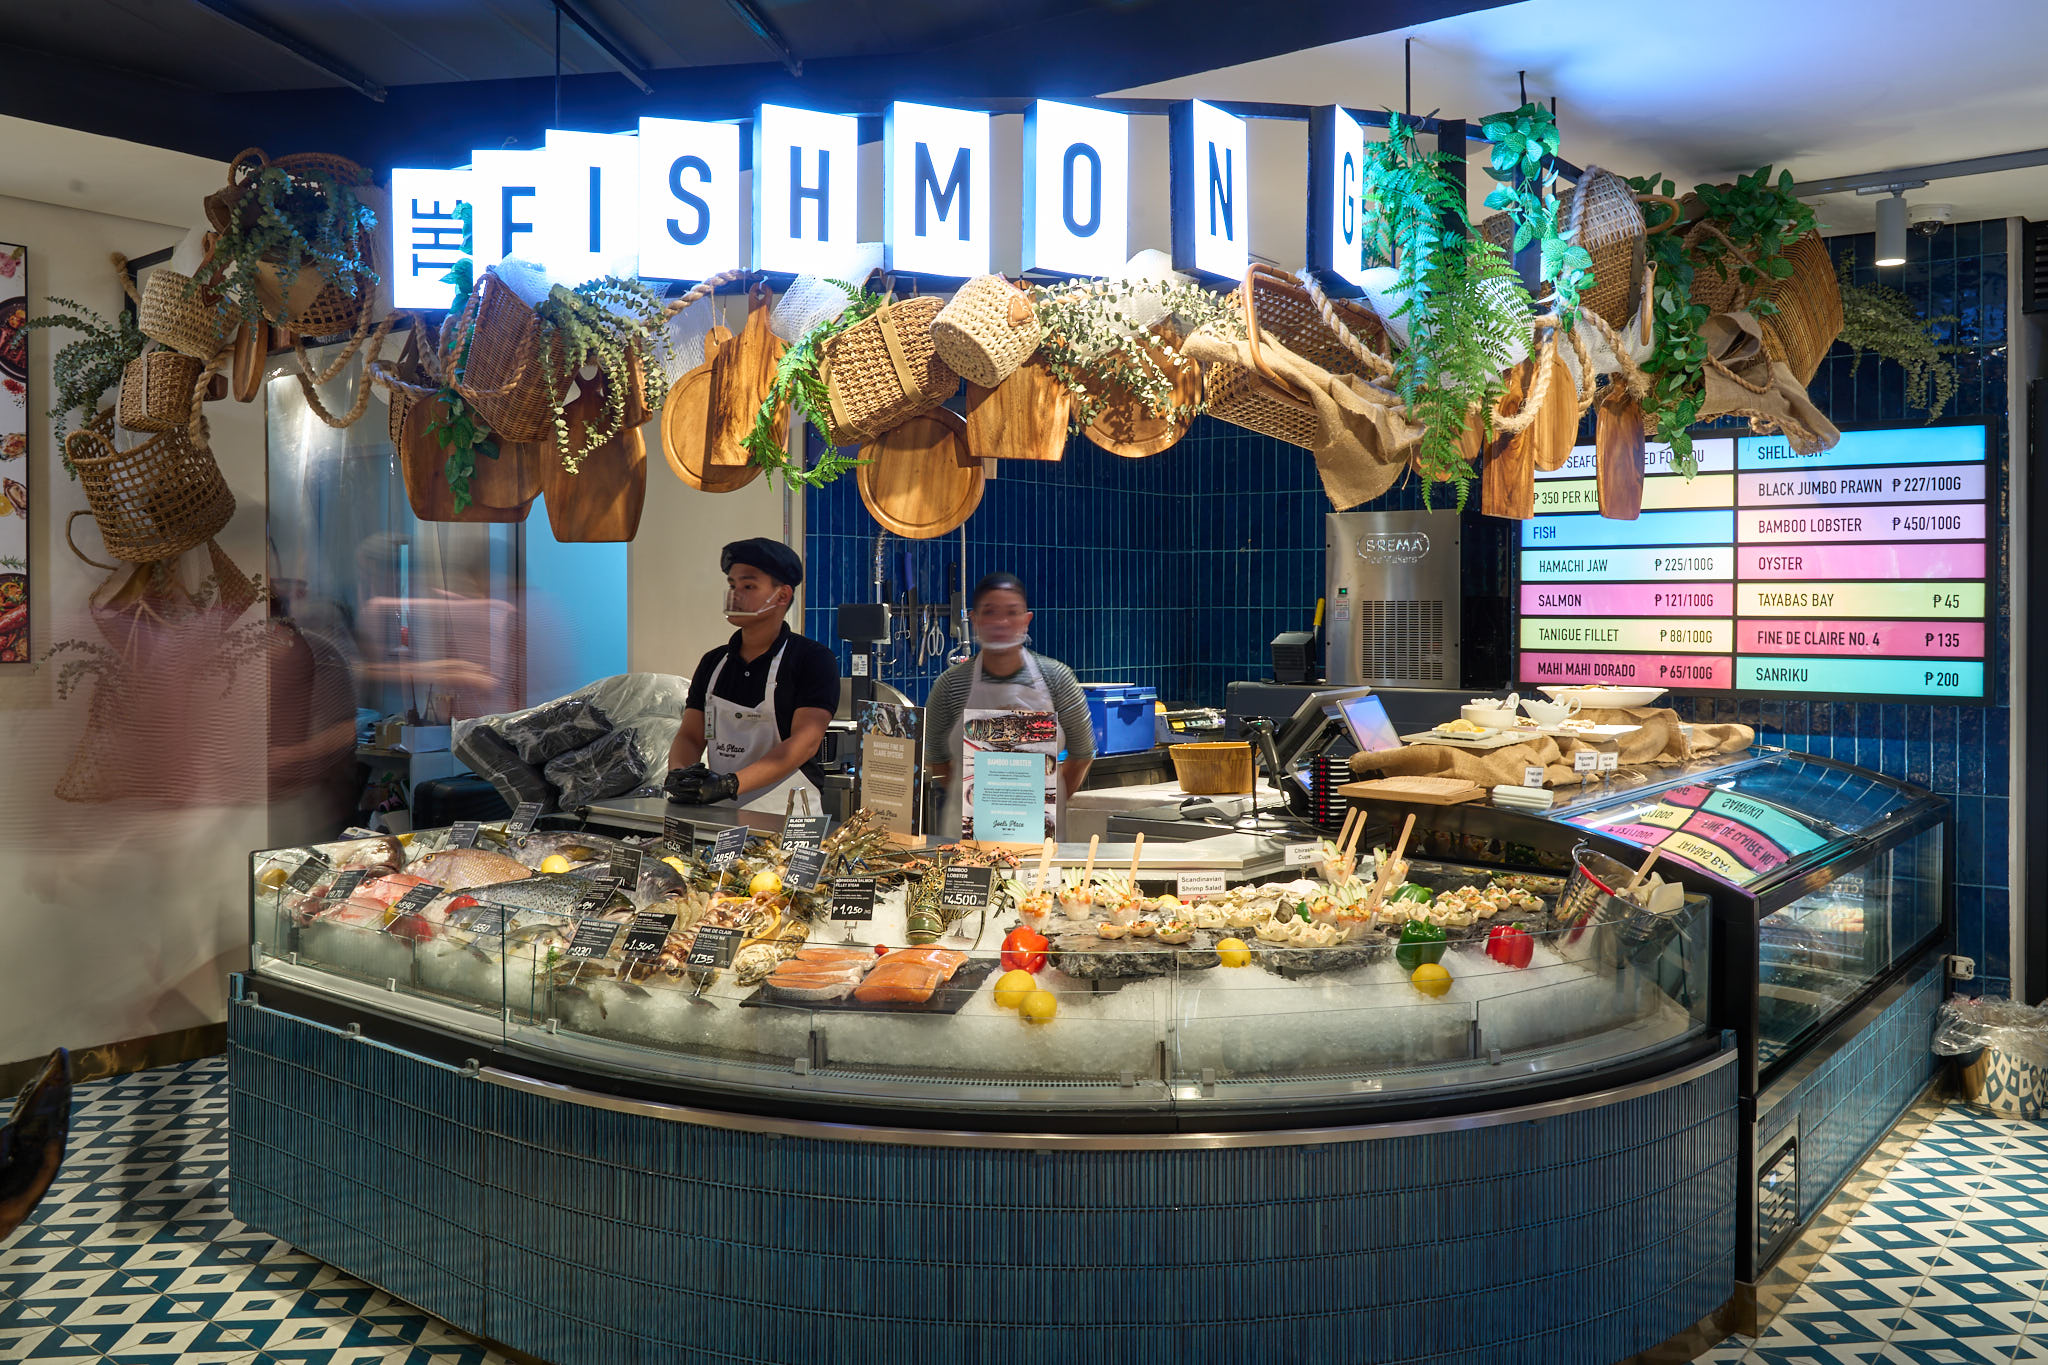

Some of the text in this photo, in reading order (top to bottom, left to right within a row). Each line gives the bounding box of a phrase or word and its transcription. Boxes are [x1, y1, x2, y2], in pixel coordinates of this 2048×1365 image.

[411, 199, 463, 276] THE
[1759, 481, 1794, 496] BLACK
[1797, 480, 1836, 495] JUMBO
[1841, 478, 1882, 494] PRAWN
[1904, 476, 1961, 492] 227/100G
[1542, 491, 1559, 504] 350
[1562, 490, 1581, 503] PER
[1585, 489, 1599, 503] KIL
[1759, 518, 1806, 533] BAMBOO
[1810, 517, 1862, 532] LOBSTER
[1904, 515, 1961, 531] 450/100G
[1533, 526, 1556, 539] FISH
[1539, 560, 1584, 573] HAMACHI
[1587, 559, 1608, 572] JAW
[1665, 558, 1713, 571] 225/100G
[1758, 556, 1803, 570] OYSTER
[1538, 594, 1582, 607] SALMON
[1665, 593, 1713, 607] 121/100G
[1758, 593, 1807, 607] TAYABAS
[1812, 593, 1834, 607] BAY
[1944, 594, 1960, 609] 45
[1539, 628, 1581, 641] TANIGUE
[1585, 628, 1619, 642] FILLET
[1670, 630, 1713, 643] 88/100G
[1757, 630, 1782, 645] FINE
[1786, 631, 1800, 645] DE
[1804, 631, 1845, 646] CLAIRE
[1849, 632, 1868, 646] NO.
[1872, 632, 1880, 646] 4
[1938, 633, 1960, 648] 135
[1537, 662, 1563, 676] MAHI
[1566, 662, 1591, 676] MAHI
[1594, 663, 1635, 677] DORADO
[1670, 665, 1713, 679] 65/100G
[1756, 667, 1808, 682] SANRIKU
[1937, 672, 1959, 687] 200
